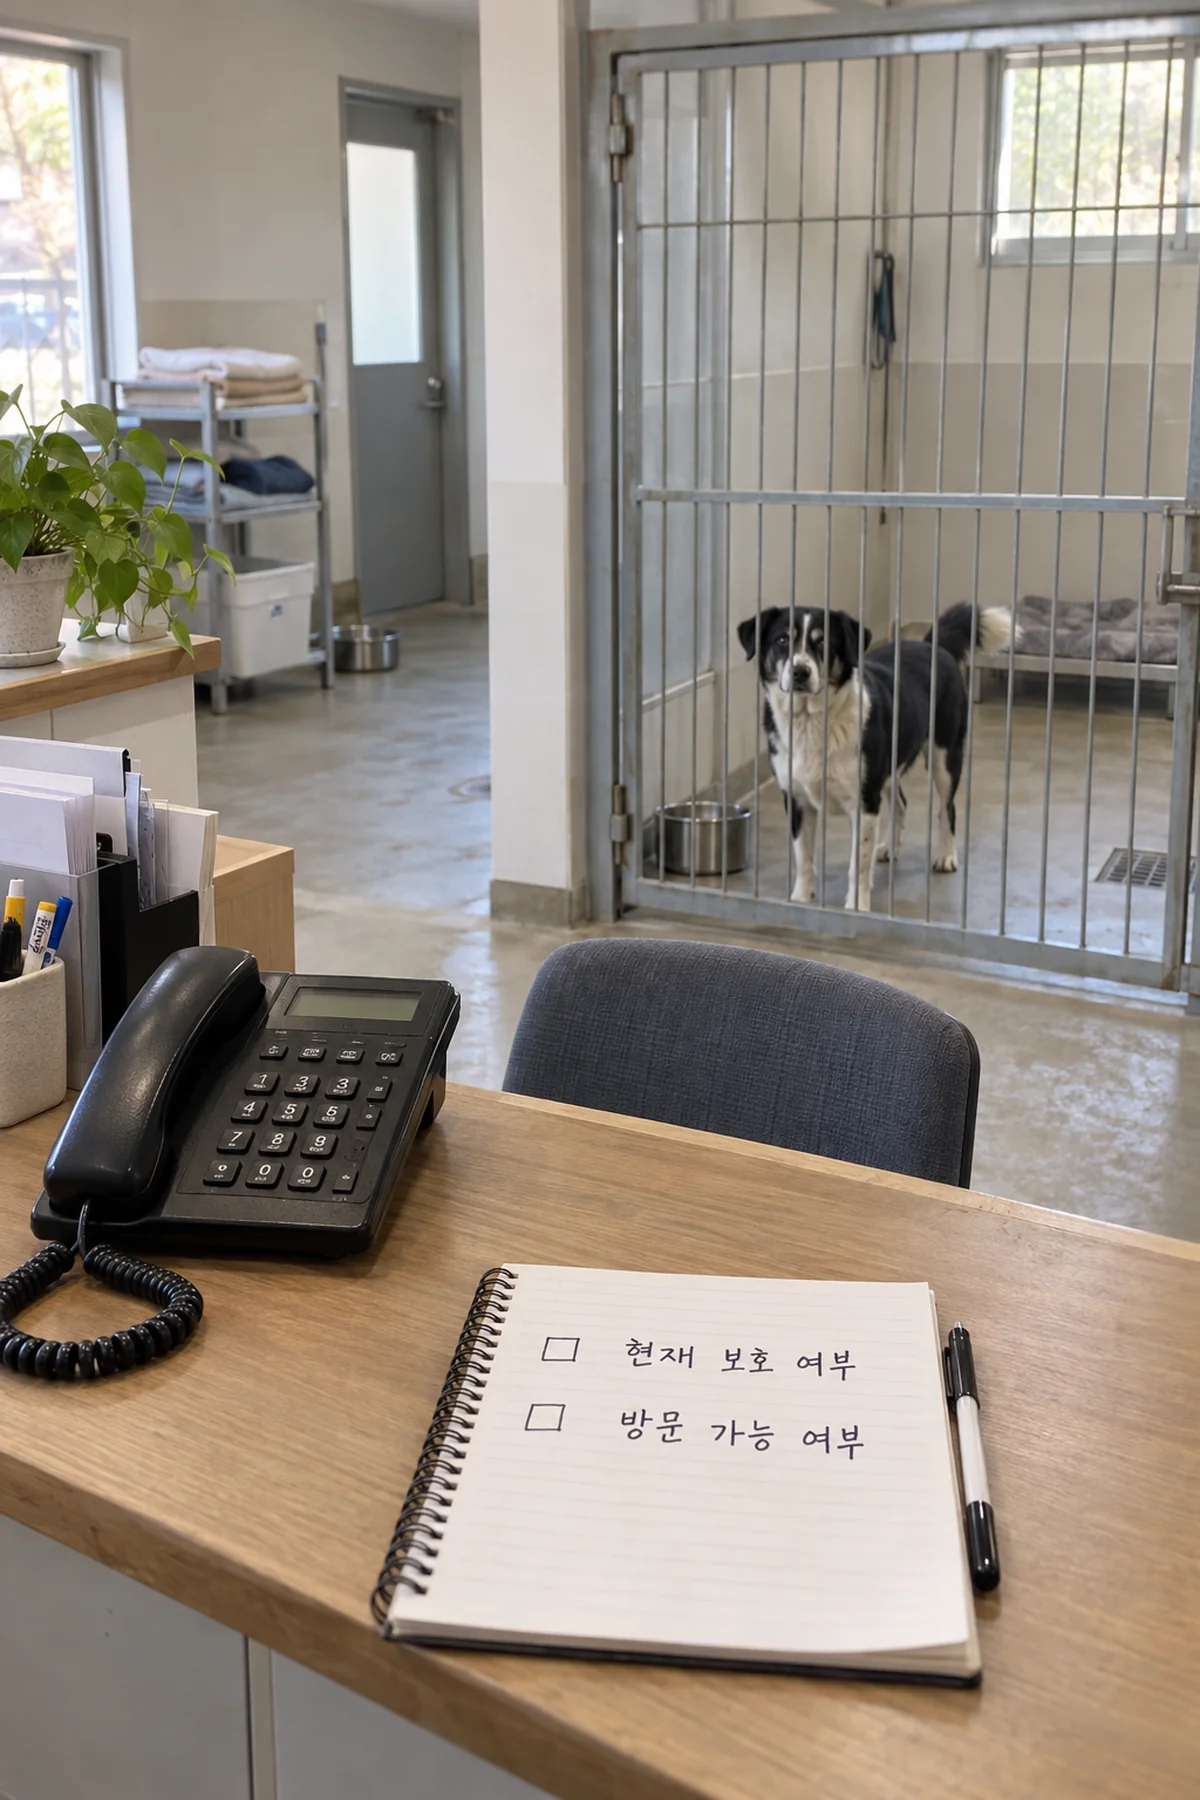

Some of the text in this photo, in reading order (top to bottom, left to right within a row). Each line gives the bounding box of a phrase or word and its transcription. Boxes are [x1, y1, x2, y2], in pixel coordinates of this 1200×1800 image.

[259, 1074, 268, 1085] 1
[337, 1078, 349, 1089] 3
[244, 1102, 255, 1112] 4
[285, 1104, 297, 1114] 5
[231, 1132, 243, 1141] 7
[272, 1133, 284, 1144] 8
[315, 1136, 326, 1146] 9
[259, 1164, 271, 1175] 0
[302, 1167, 314, 1178] 0
[626, 1338, 855, 1381] 현재 보호 여부
[621, 1409, 864, 1460] 방문 가능 여부
